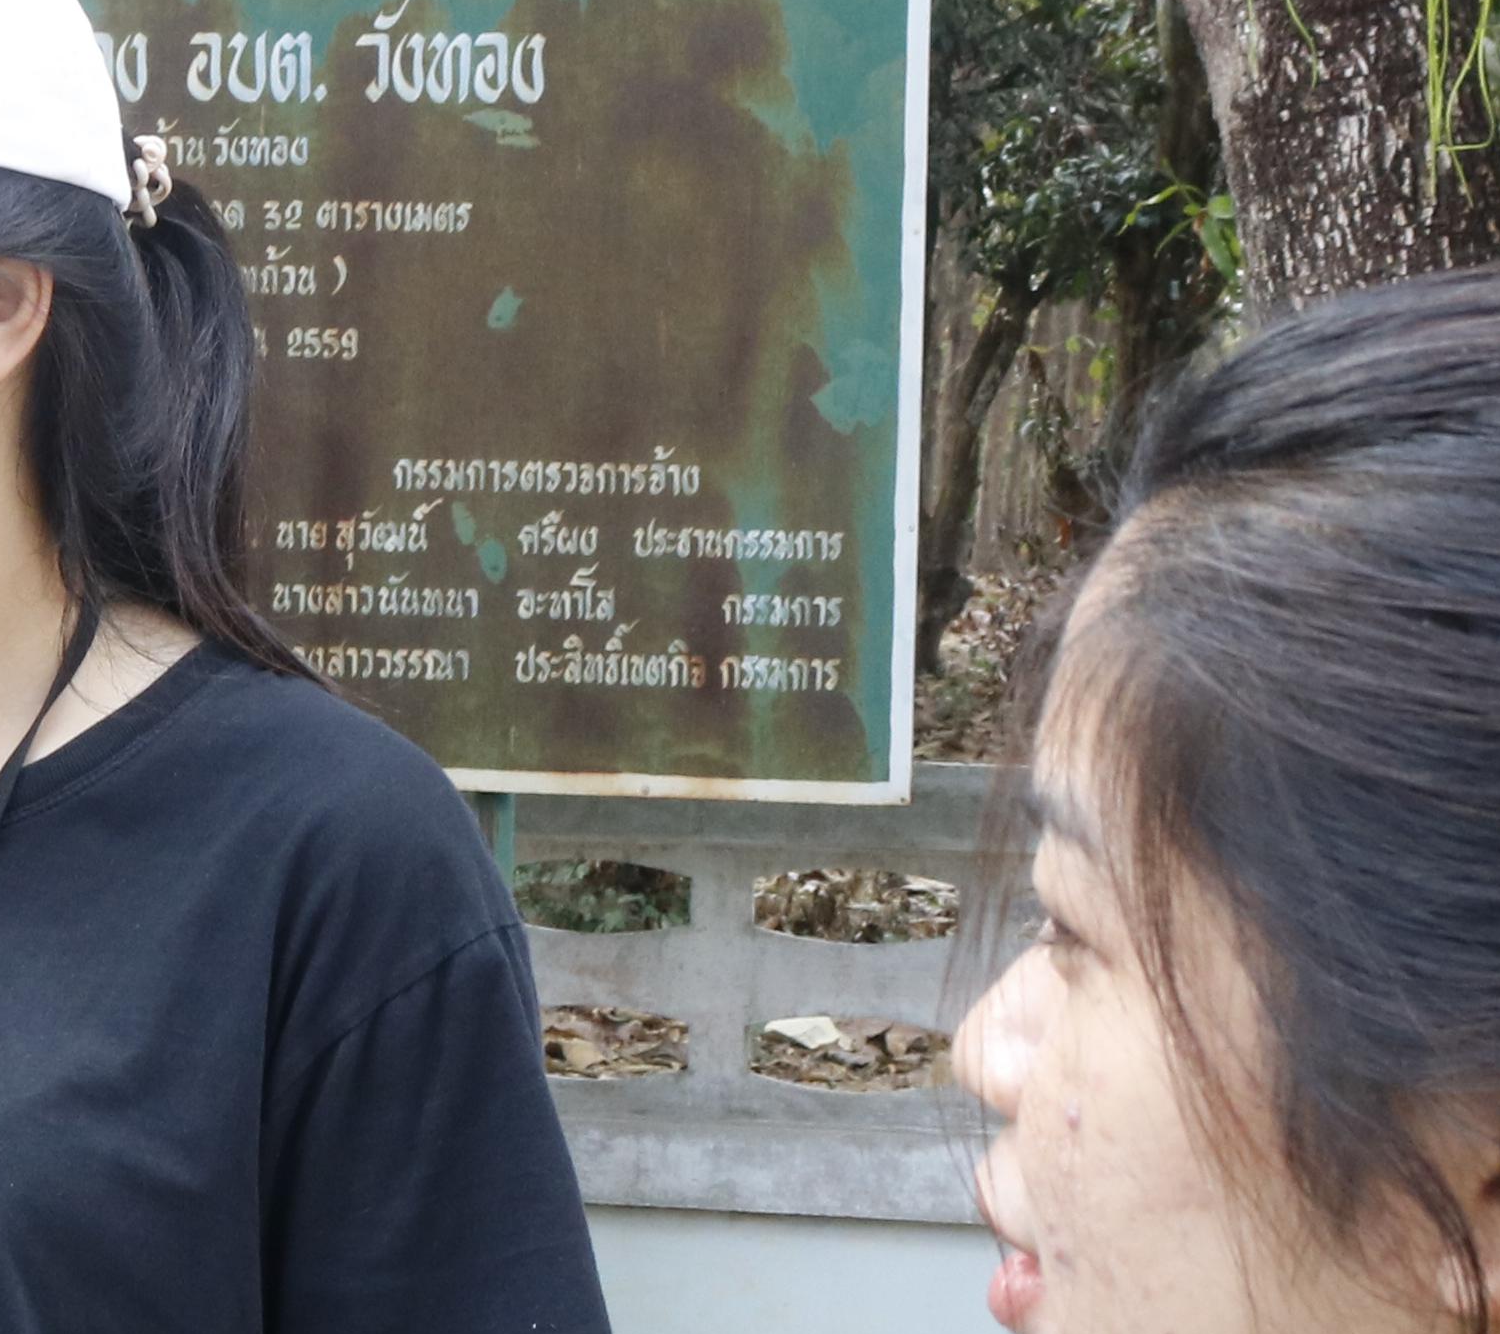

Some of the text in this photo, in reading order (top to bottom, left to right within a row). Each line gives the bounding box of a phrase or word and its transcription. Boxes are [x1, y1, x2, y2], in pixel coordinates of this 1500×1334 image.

[186, 29, 328, 104] อบต.
[262, 199, 304, 231] 32
[316, 199, 474, 234] ตารางเมตร
[286, 326, 359, 361] 2559
[392, 445, 701, 497] กรรมการตรวจการจ้าง
[275, 519, 328, 551] นาย
[632, 517, 845, 561] ประธานกรรมการ
[720, 593, 845, 628] กรรมการ
[719, 654, 842, 693] กรรมการ
